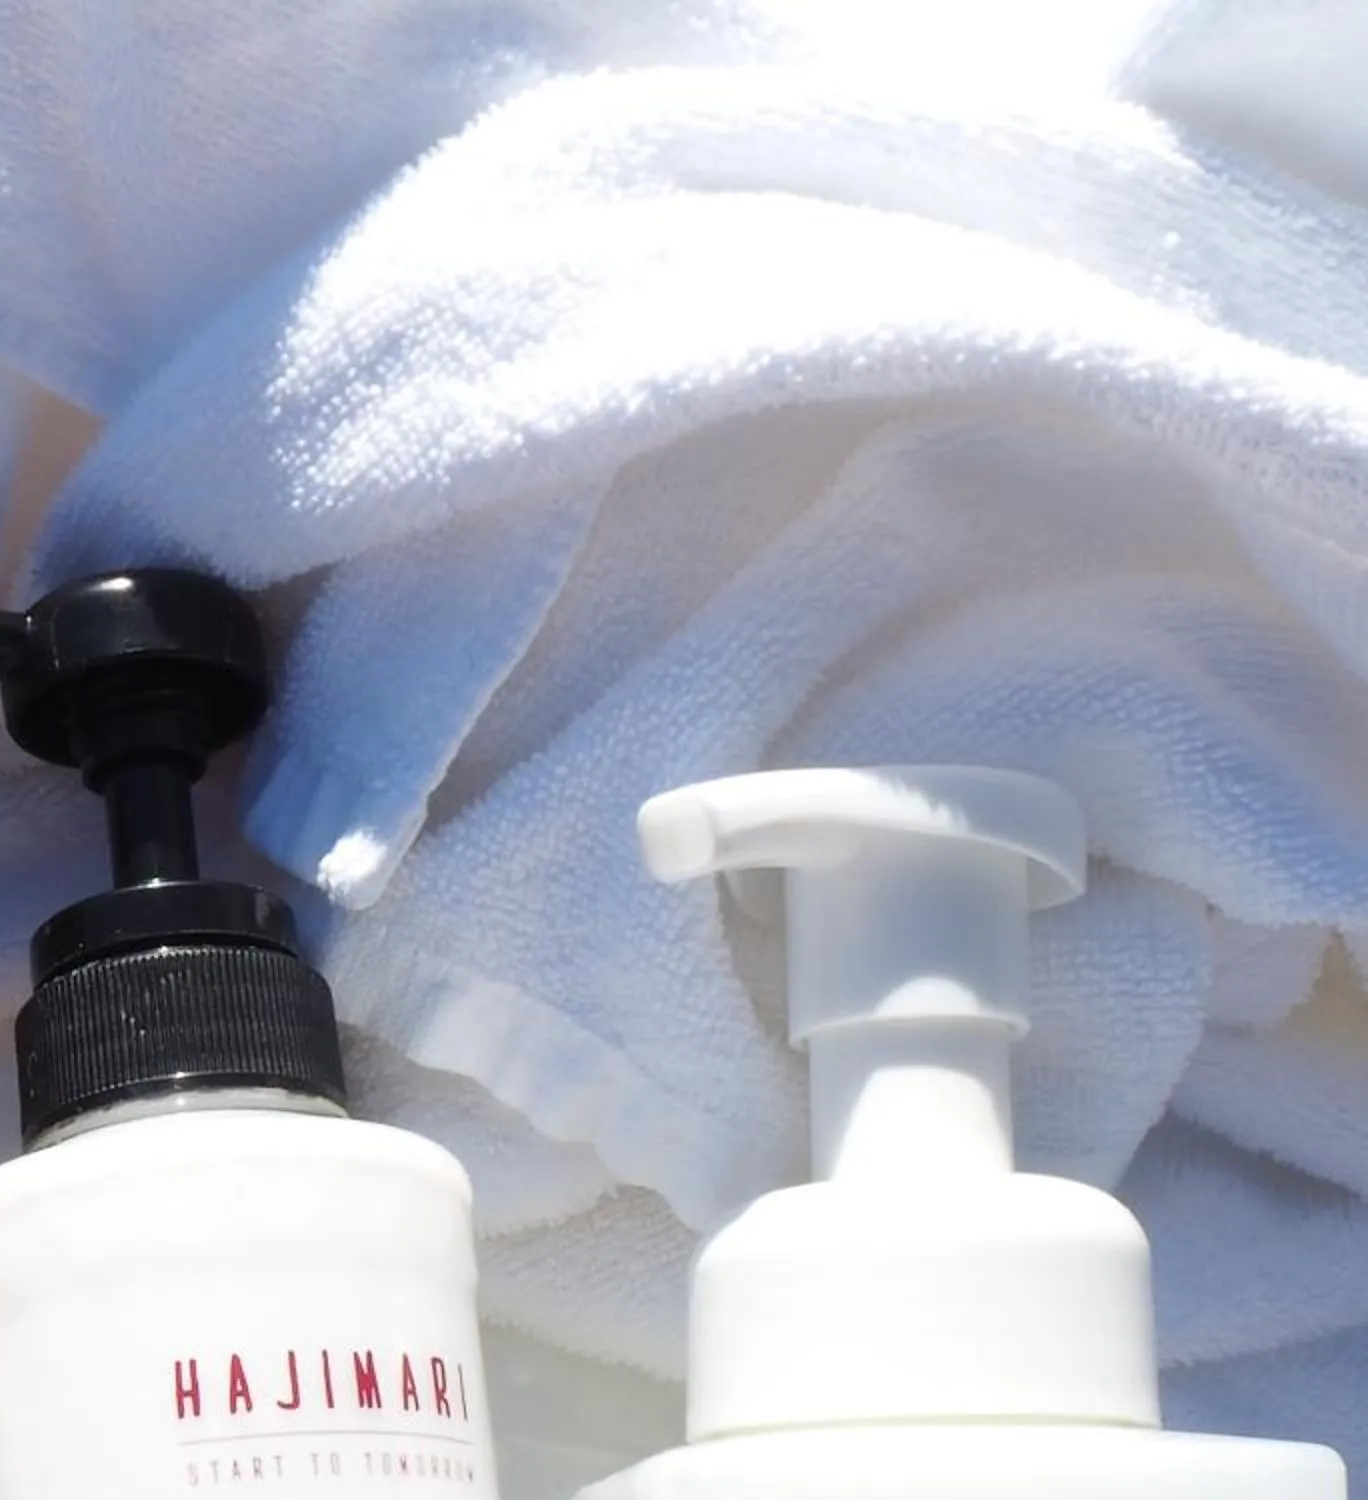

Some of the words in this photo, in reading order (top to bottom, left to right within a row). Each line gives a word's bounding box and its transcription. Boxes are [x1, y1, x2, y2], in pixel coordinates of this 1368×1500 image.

[174, 1349, 469, 1421] HAJIMARI
[186, 1455, 283, 1487] START
[310, 1452, 341, 1476] TO
